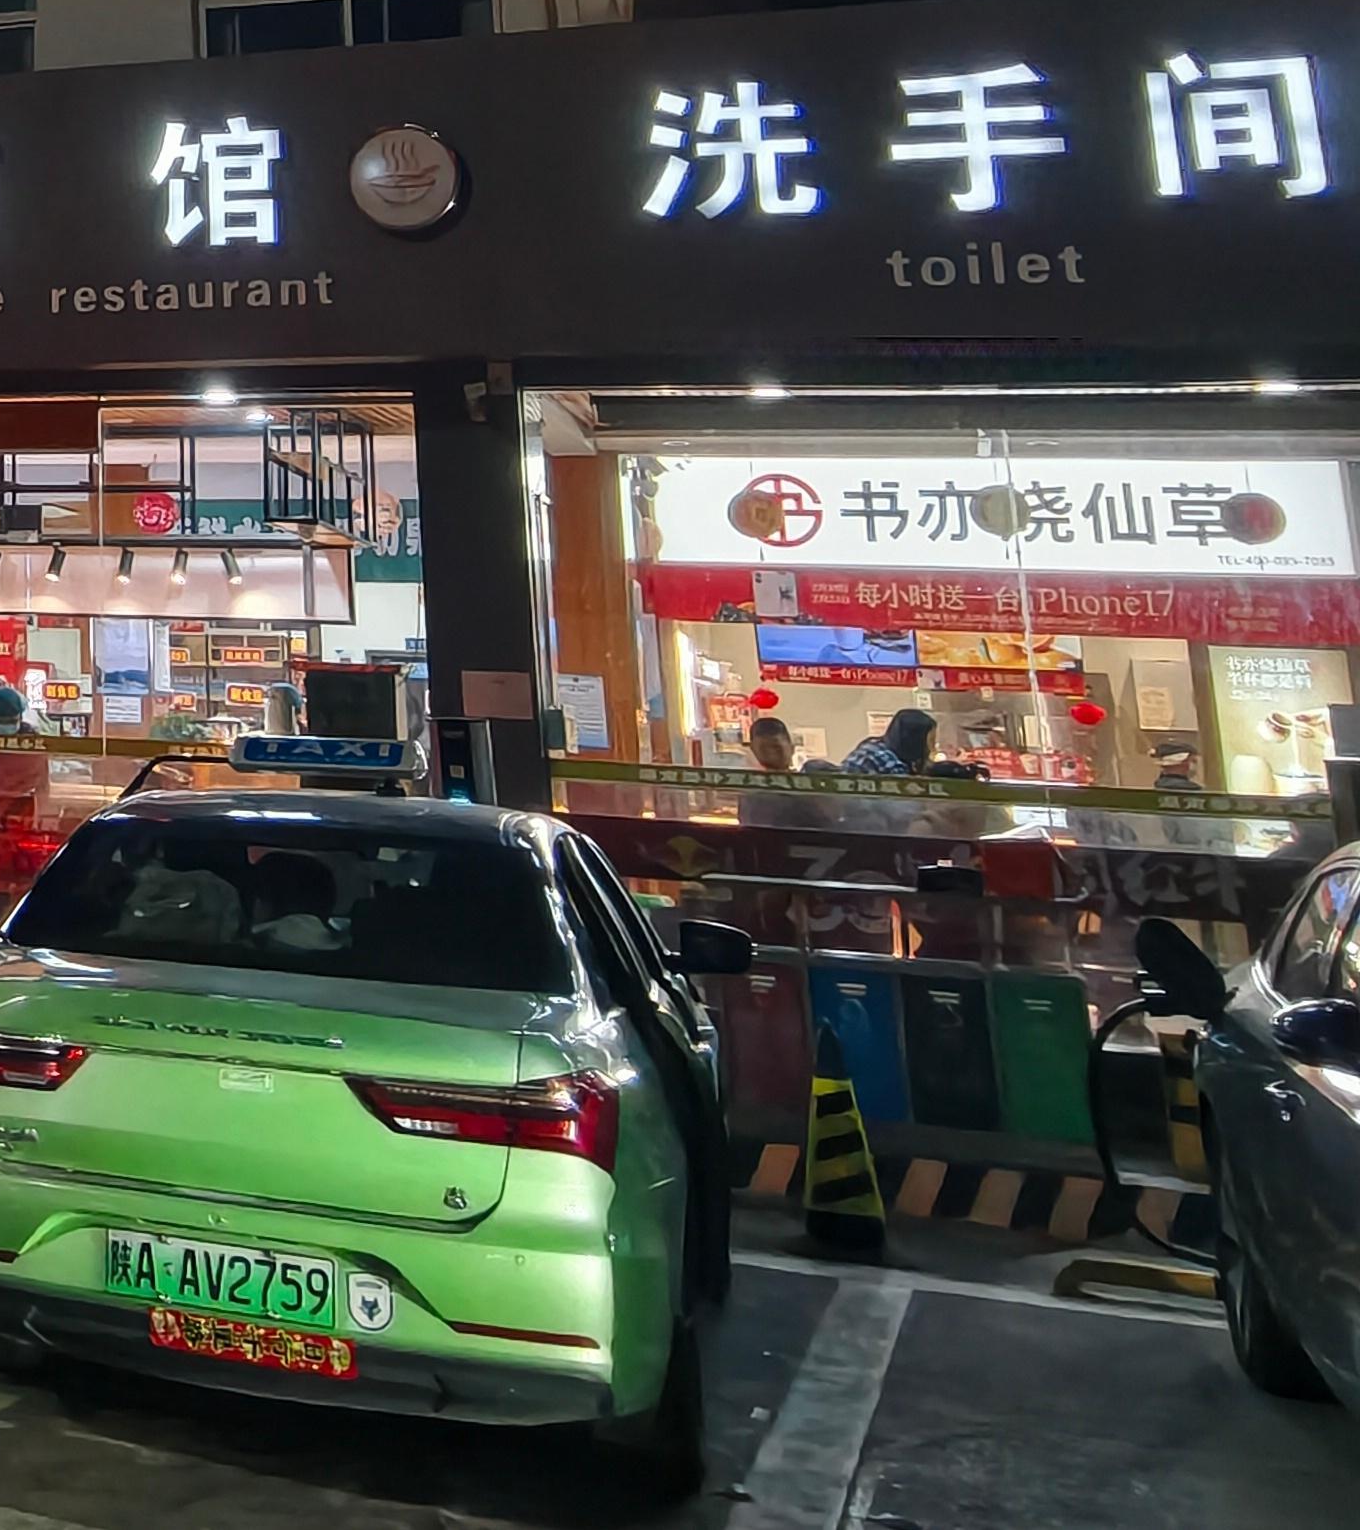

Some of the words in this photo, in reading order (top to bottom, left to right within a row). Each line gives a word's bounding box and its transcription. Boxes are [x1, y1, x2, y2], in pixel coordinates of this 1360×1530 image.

[642, 50, 1330, 219] 洗手间
[886, 241, 1085, 287] toilet
[50, 270, 335, 314] restaurant
